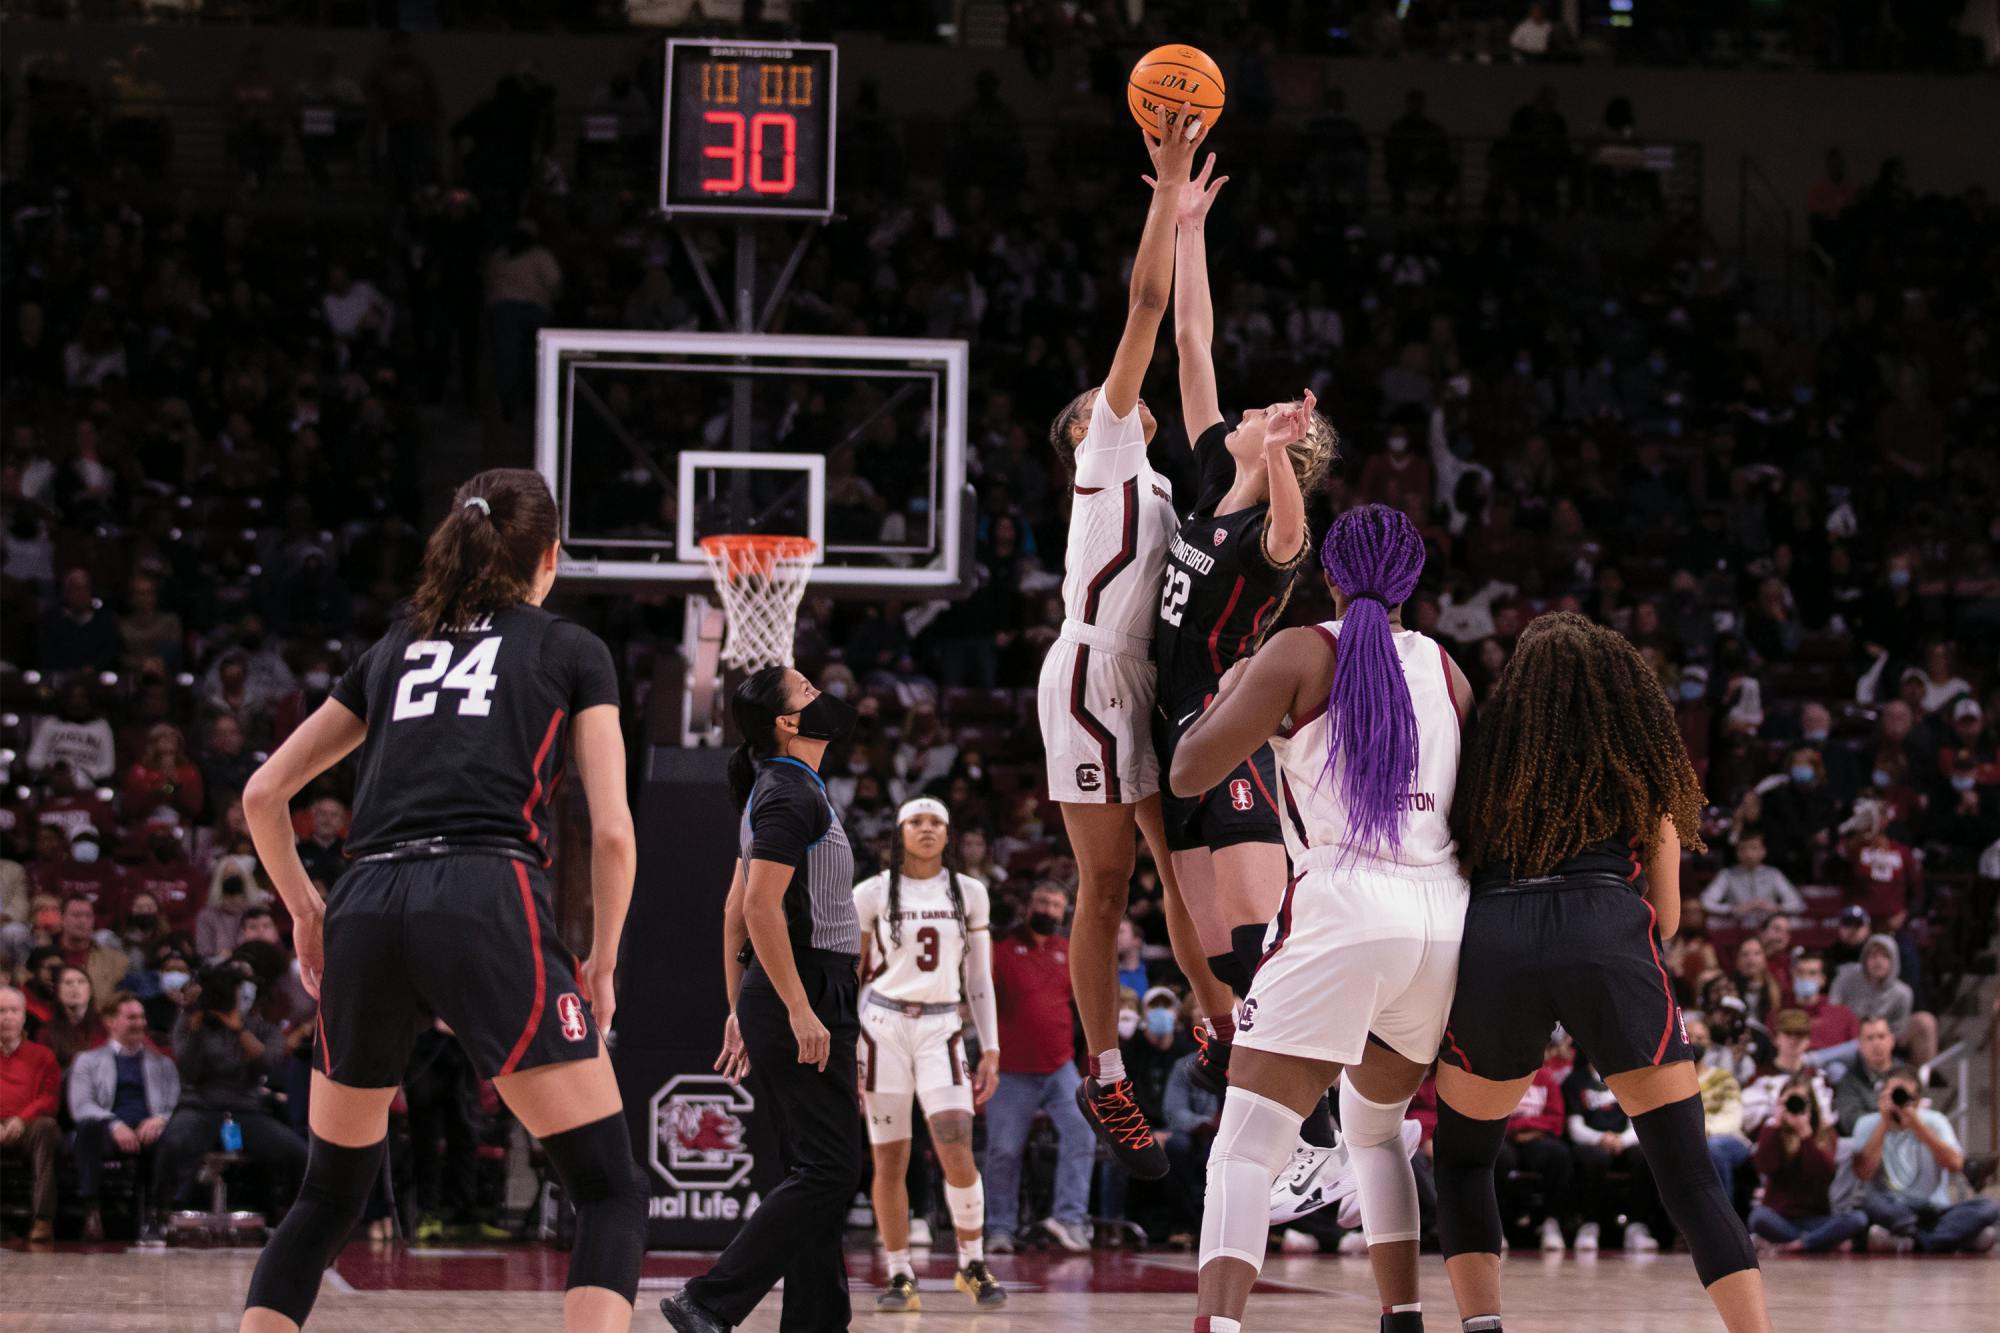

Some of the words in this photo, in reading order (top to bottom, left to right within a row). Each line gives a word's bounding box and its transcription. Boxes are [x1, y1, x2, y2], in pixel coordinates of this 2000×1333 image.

[703, 112, 796, 193] 30
[1169, 531, 1215, 576] TANFORD
[393, 636, 503, 721] 24
[1394, 792, 1435, 812] STON
[916, 926, 939, 972] 3
[691, 1190, 740, 1219] Life
